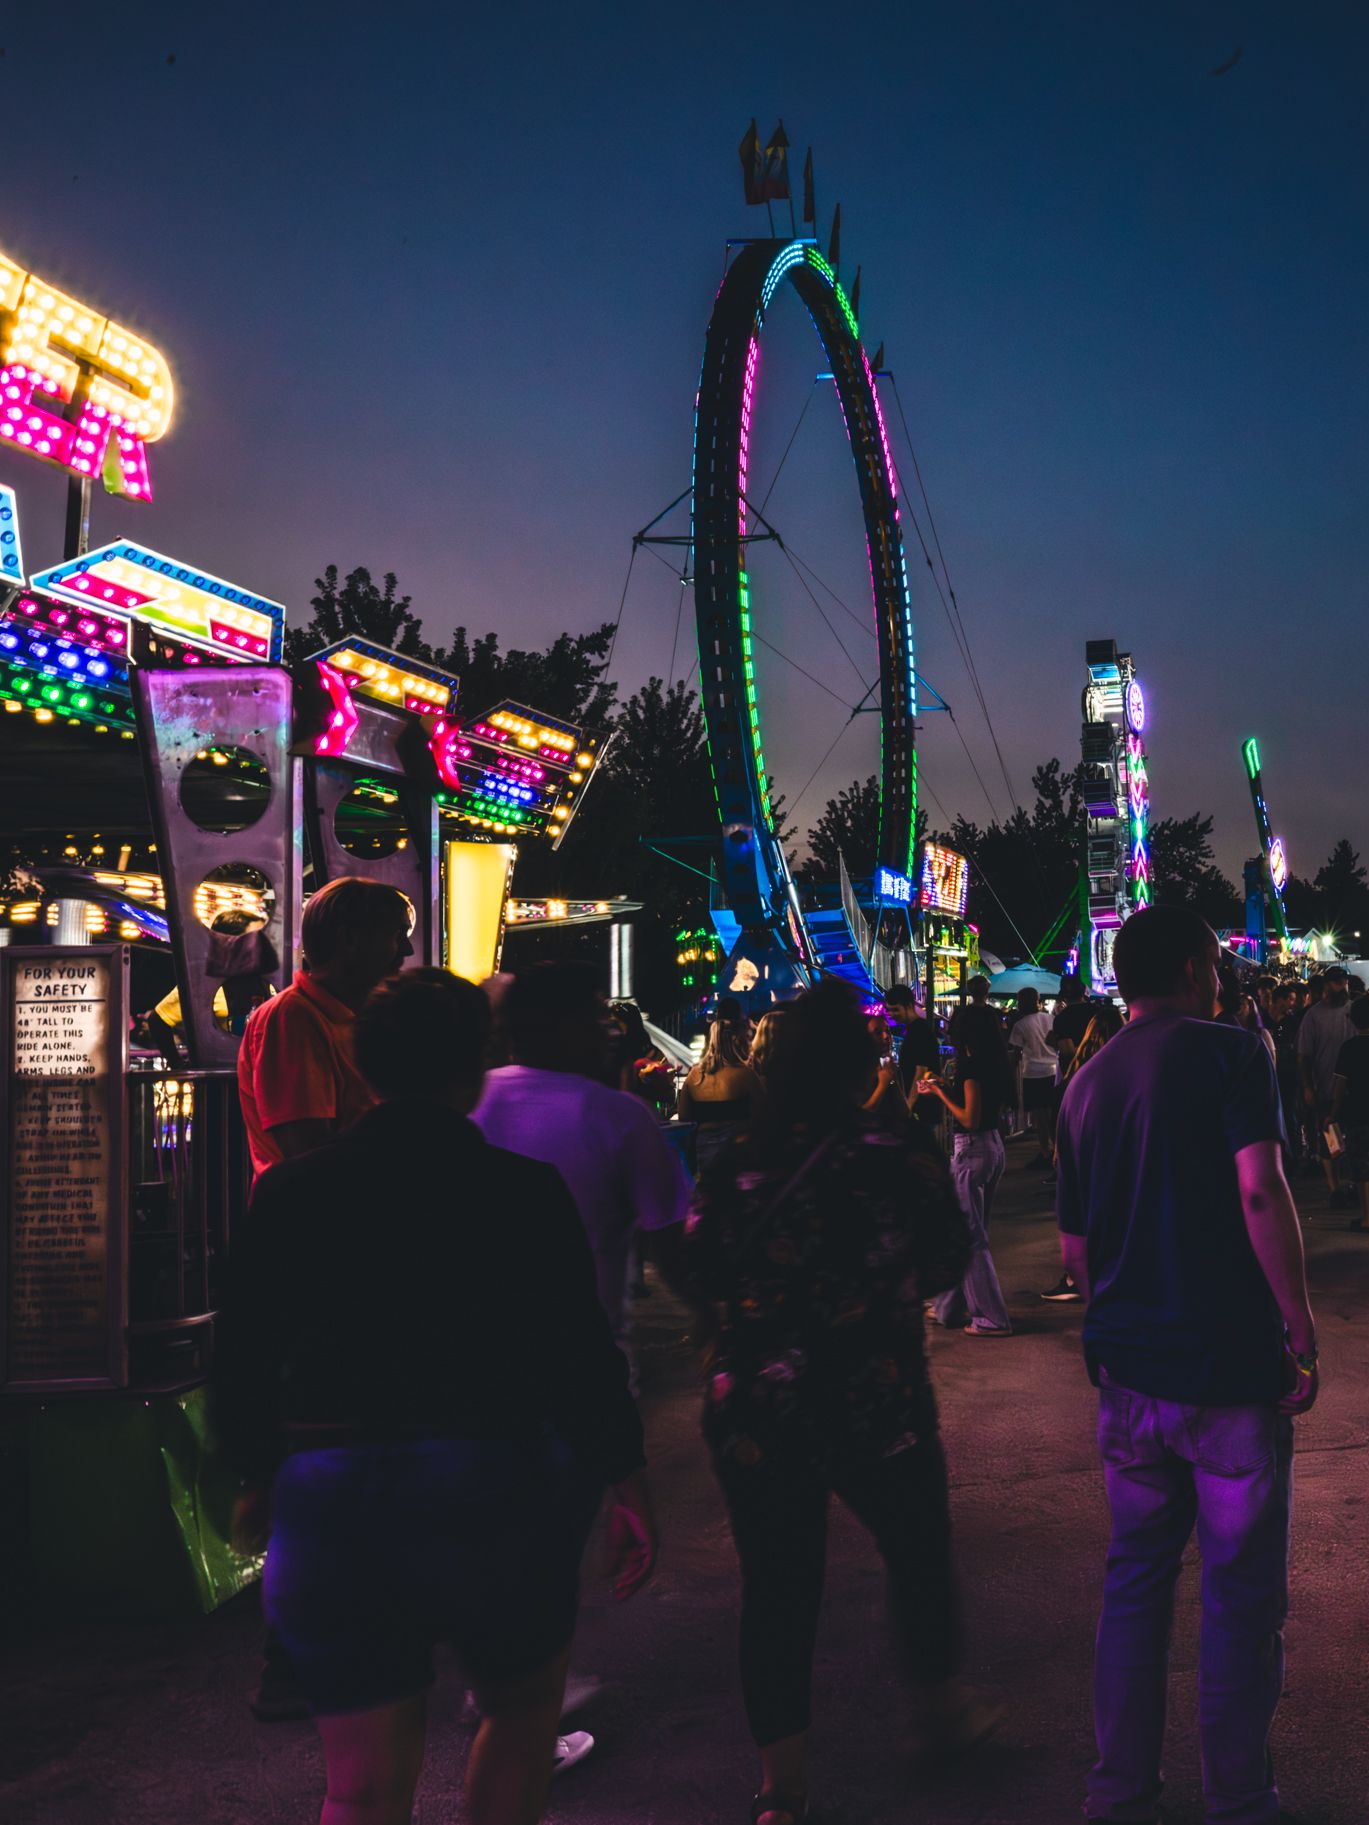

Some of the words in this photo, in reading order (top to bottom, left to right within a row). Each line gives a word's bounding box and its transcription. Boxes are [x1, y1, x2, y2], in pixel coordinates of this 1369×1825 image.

[24, 967, 52, 980] FOR
[58, 966, 96, 979] YOUR
[33, 983, 87, 997] SAFETY
[18, 1006, 26, 1014] 1.
[30, 1005, 49, 1014] YOU
[52, 1004, 77, 1013] MUST
[80, 1004, 93, 1013] BE
[37, 1018, 58, 1026] TALL
[62, 1017, 74, 1025] TO
[16, 1030, 59, 1039] OPERATE
[63, 1029, 84, 1038] THIS
[16, 1042, 38, 1051] RIDE
[29, 1054, 53, 1063] KEEP
[76, 1066, 96, 1075] AND
